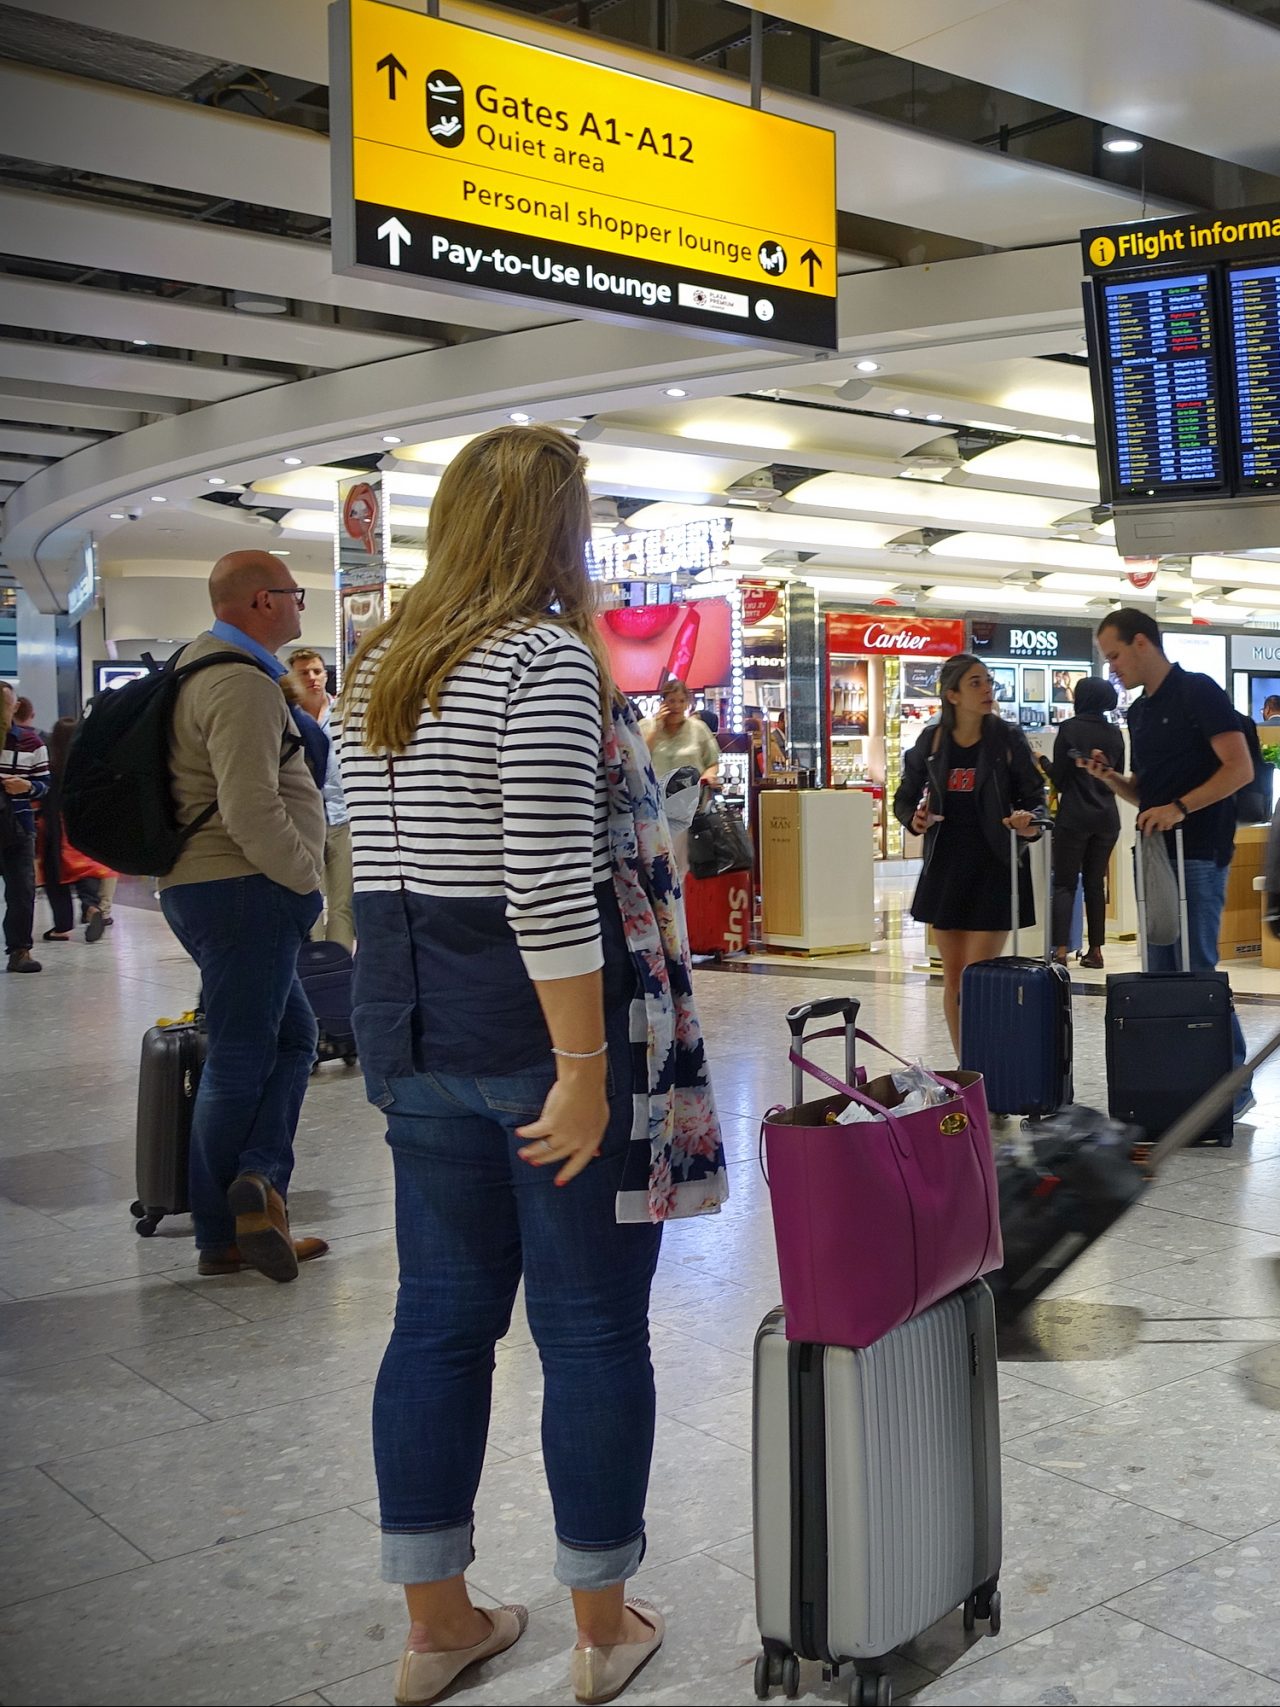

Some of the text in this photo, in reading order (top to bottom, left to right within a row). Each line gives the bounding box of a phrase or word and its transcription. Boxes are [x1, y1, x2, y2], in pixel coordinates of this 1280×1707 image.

[475, 83, 695, 164] Gates A1-A12
[477, 124, 606, 173] Quiet area
[462, 180, 753, 263] Personal shopper lounge
[1117, 228, 1185, 259] Flight
[431, 234, 672, 306] Pay-to-Use lounge
[863, 623, 930, 649] Cartier
[1010, 629, 1058, 650] BOSS
[770, 820, 791, 829] MAN
